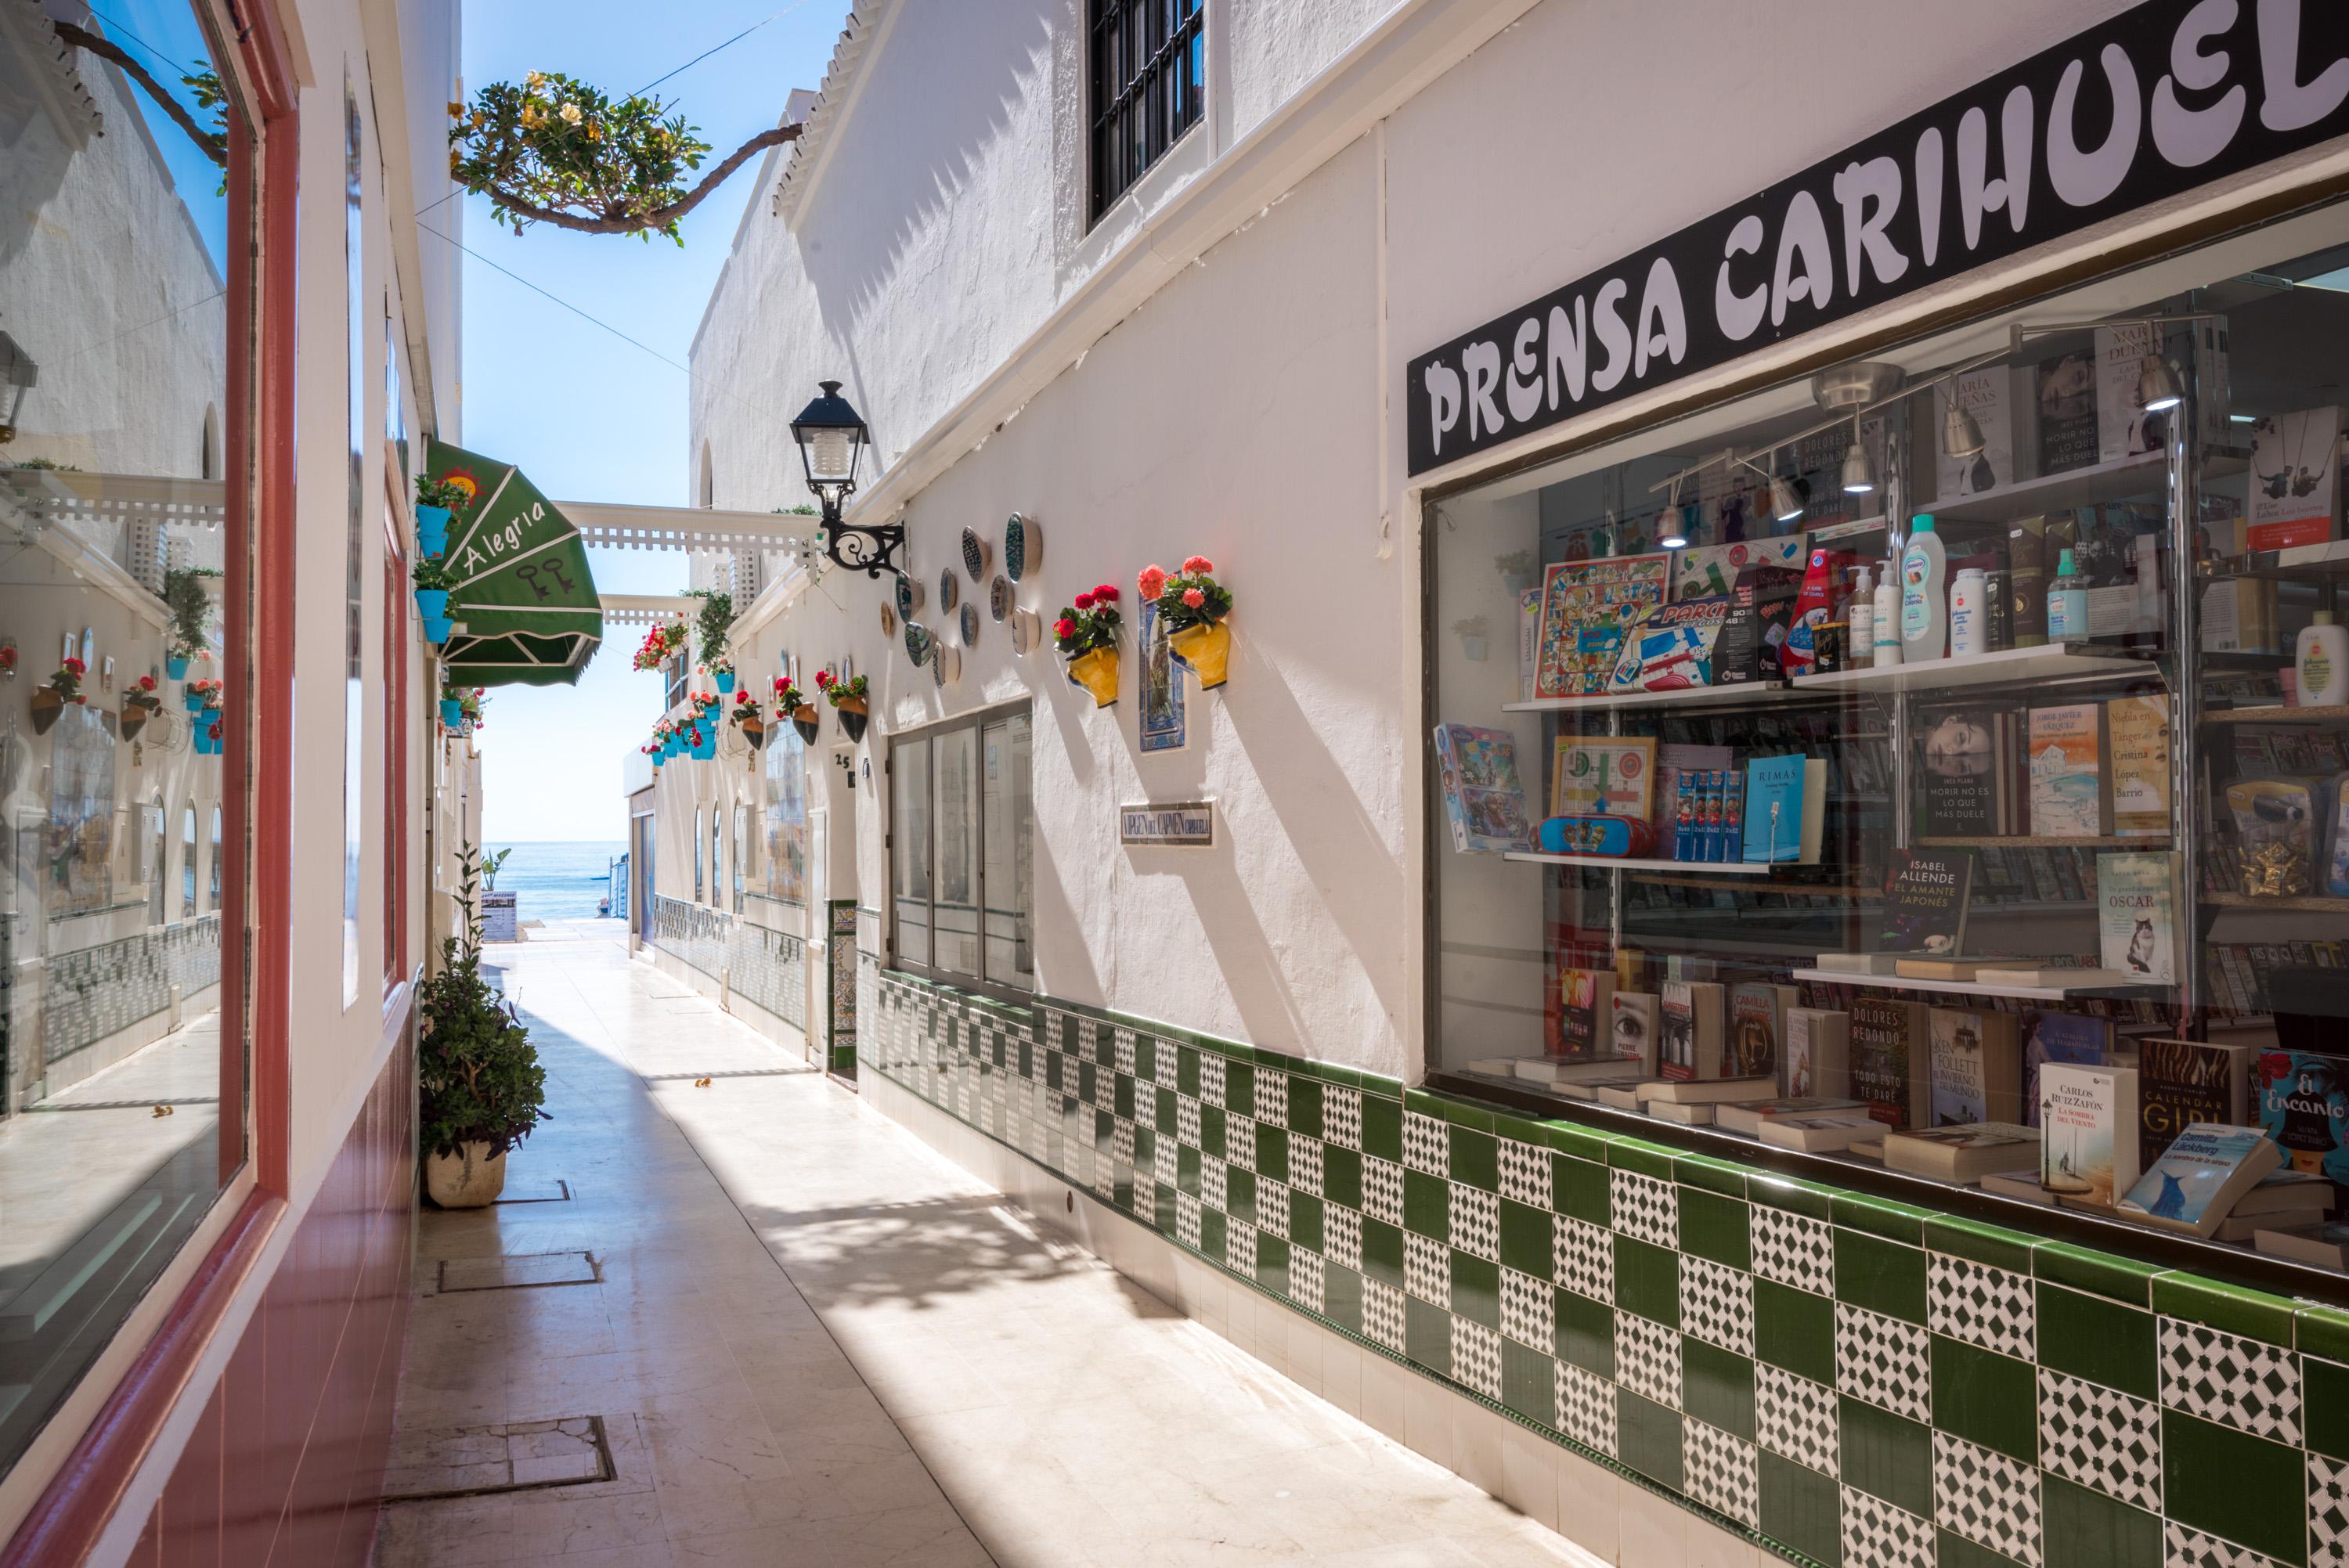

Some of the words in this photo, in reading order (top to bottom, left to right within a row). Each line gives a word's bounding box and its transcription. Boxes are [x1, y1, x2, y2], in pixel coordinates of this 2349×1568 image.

[1425, 257, 1687, 456] PRENSA
[1716, 0, 2349, 341] CARIHUEL
[2113, 323, 2166, 344] MARA
[1961, 376, 1990, 393] ARÍA
[1805, 431, 1848, 452] DOLORES
[2045, 431, 2076, 445] MORIR
[2080, 426, 2094, 436] NO
[2059, 443, 2072, 452] LO
[2075, 438, 2095, 449] QUE
[2073, 450, 2098, 462] DUEL
[1662, 601, 1728, 624] PARCH
[2037, 714, 2057, 723] JORGE
[2059, 711, 2082, 720] JAVIER
[2111, 712, 2137, 723] Niebla
[835, 753, 850, 769] 25
[2114, 749, 2149, 761] Cristina
[1759, 769, 1797, 782] RIMAS
[2116, 769, 2140, 783] López
[1978, 787, 1990, 795] ES
[2116, 787, 2143, 798] Barrio
[1943, 798, 1955, 807] LO
[1958, 798, 1977, 807] QUE
[1936, 808, 1954, 819] MÁS
[1957, 809, 1986, 819] DUELE
[1911, 860, 1946, 872] ISABEL
[1899, 871, 1955, 884] ALLENDE
[1894, 883, 1905, 892] EL
[1910, 884, 1955, 897] AMANTE
[1899, 895, 1948, 908] JAPONÉS
[2109, 896, 2155, 908] OSCAR
[1662, 1000, 1690, 1015] JUNGSTEDT
[1853, 1007, 1898, 1026] DOLORES
[1853, 1026, 1900, 1046] REDONDO
[1618, 1043, 1636, 1052] PIERRE
[1933, 1038, 1955, 1054] KEN
[1938, 1054, 1979, 1076] FOLLETT
[1854, 1069, 1876, 1084] TODO
[1880, 1075, 1901, 1088] ESTO
[1933, 1070, 1939, 1079] EL
[1940, 1070, 1976, 1087] INVIERNO
[1860, 1087, 1871, 1098] TE
[1874, 1088, 1896, 1103] DARÉ
[1939, 1082, 1949, 1091] DEL
[1949, 1084, 1980, 1100] MUNDO
[2059, 1083, 2094, 1098] CARLOS
[2051, 1093, 2073, 1105] RUIZ
[2073, 1097, 2103, 1111] ZAFÓN
[2145, 1090, 2224, 1110] CALENDAR
[2267, 1089, 2345, 1119] Encanto
[2058, 1107, 2068, 1116] LA
[2069, 1108, 2095, 1121] SOMBRA
[2056, 1116, 2070, 1124] DEL
[2070, 1118, 2096, 1129] VIENTO
[2180, 1132, 2218, 1143] Camilla
[2171, 1142, 2220, 1156] Läckberg
